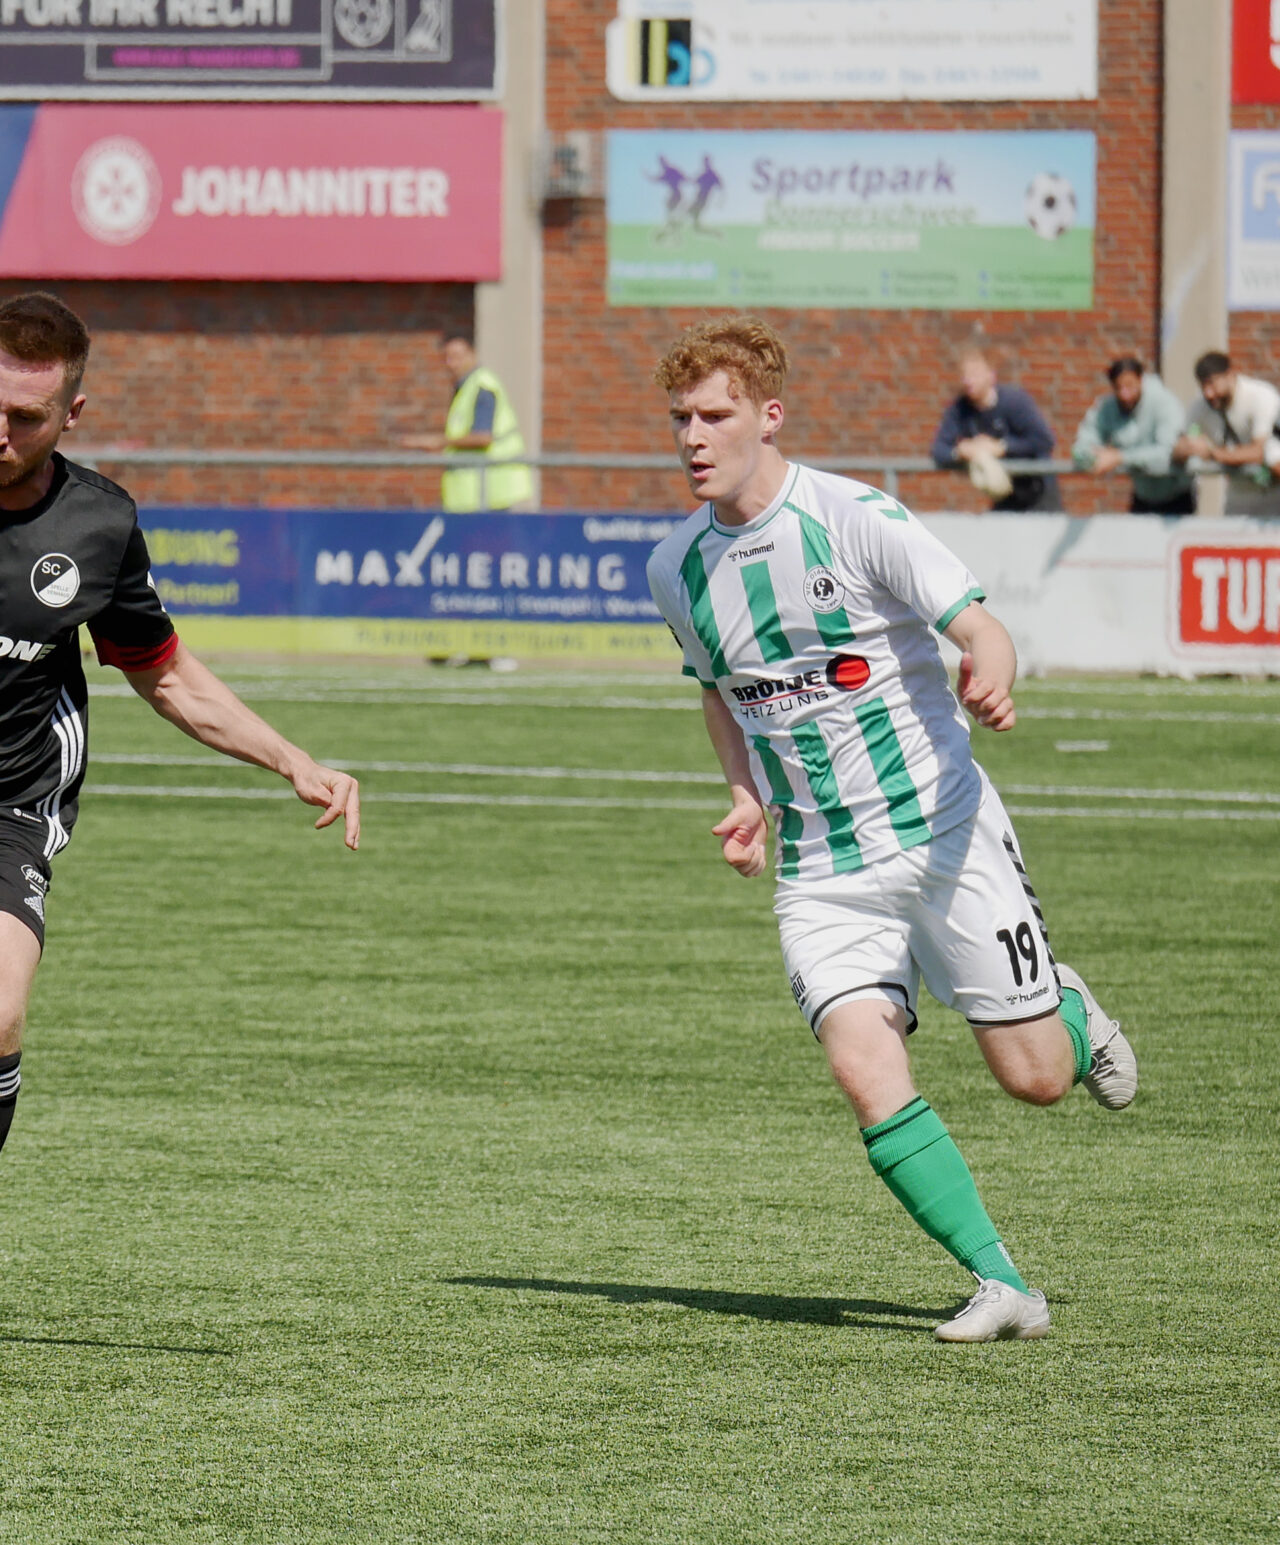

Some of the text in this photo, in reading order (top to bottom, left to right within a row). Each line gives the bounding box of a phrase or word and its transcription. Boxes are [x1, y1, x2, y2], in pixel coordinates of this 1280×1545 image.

[89, 0, 158, 26] IHR
[166, 0, 293, 26] RECHT
[172, 167, 451, 218] JOHANNITER
[751, 156, 956, 203] Sportpark
[738, 541, 775, 559] hummel
[41, 561, 61, 576] SC
[730, 670, 822, 702] BRÖTJE
[740, 690, 829, 720] HEIZUNG
[996, 921, 1038, 988] 19
[1018, 983, 1050, 1003] hummel
